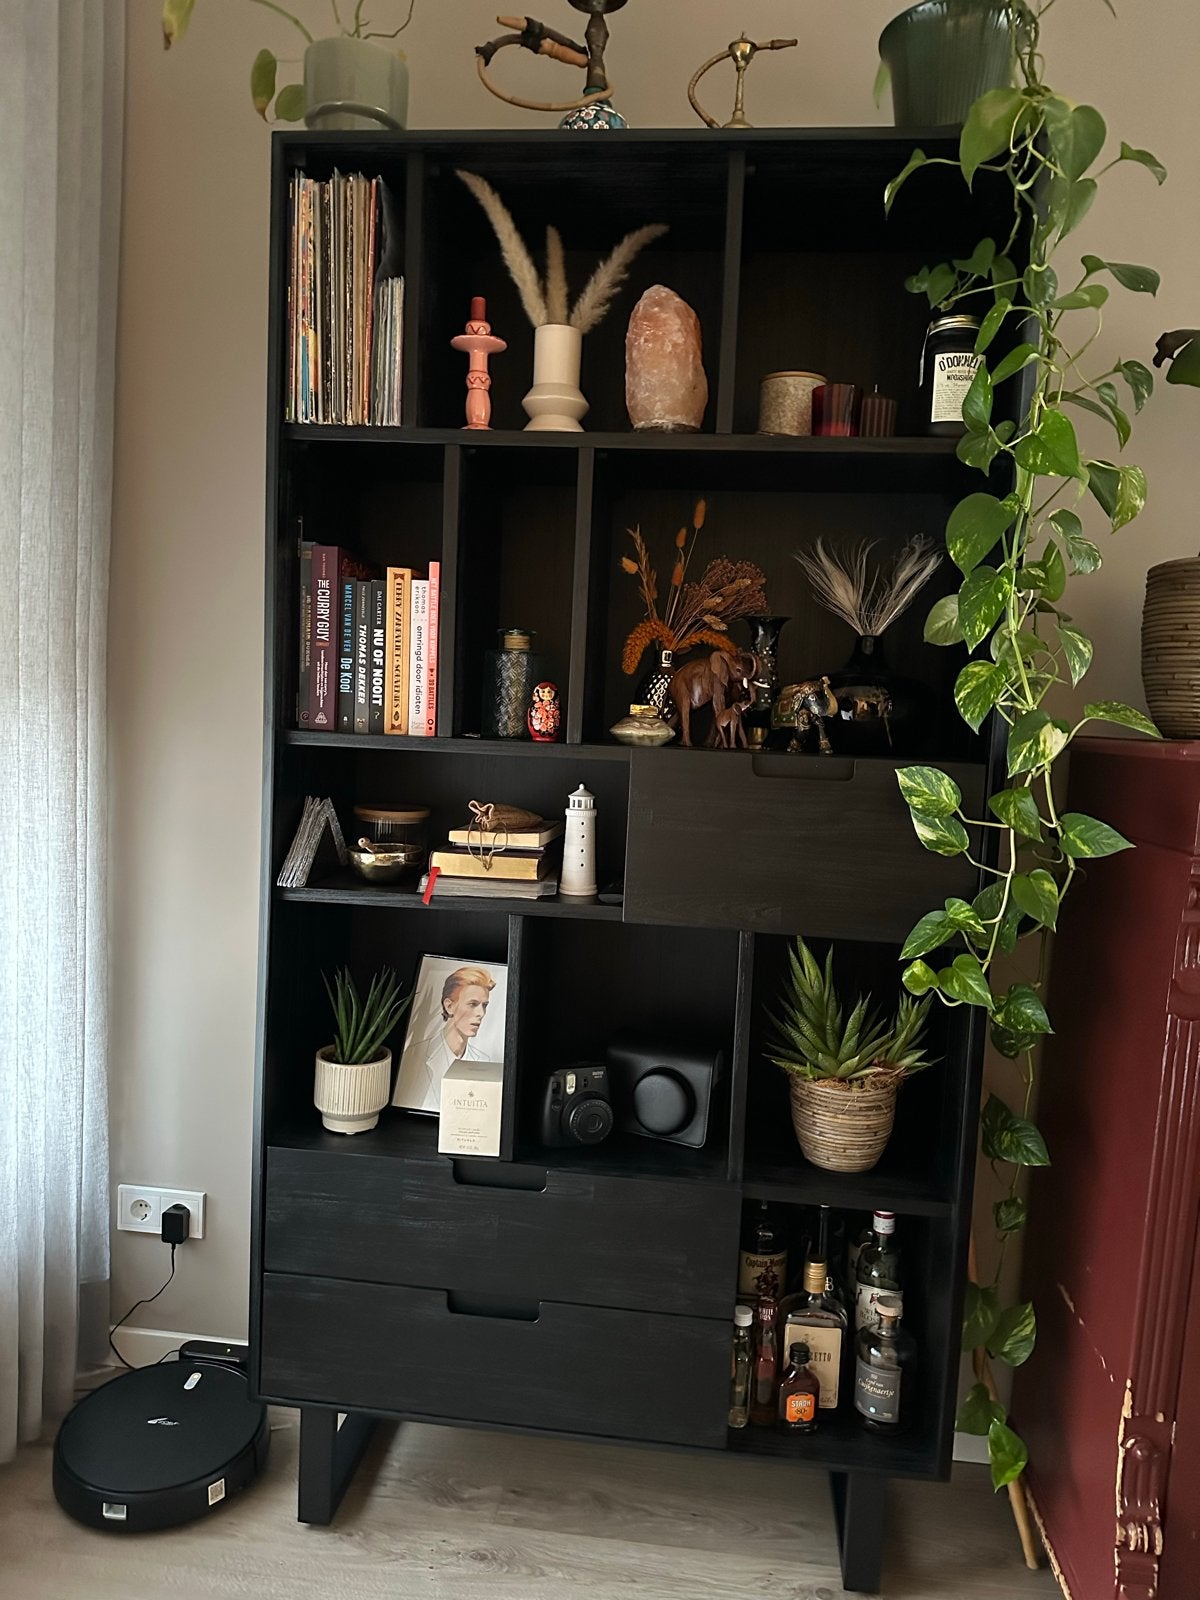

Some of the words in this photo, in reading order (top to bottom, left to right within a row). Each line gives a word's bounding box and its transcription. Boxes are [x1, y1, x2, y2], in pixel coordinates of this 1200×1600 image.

[317, 579, 330, 588] THE
[316, 588, 331, 621] CURRY
[344, 584, 352, 611] MARCEL
[344, 613, 352, 627] VAN
[316, 621, 330, 641] GUY
[343, 628, 352, 637] DE
[373, 628, 384, 647] NU
[343, 639, 351, 652] VEN
[358, 624, 367, 665] THOMAS
[414, 625, 424, 662] omringd
[340, 657, 353, 670] De
[372, 649, 384, 666] OF
[339, 672, 353, 693] Kooi
[414, 663, 423, 683] door
[357, 666, 366, 704] DEKKER
[372, 668, 383, 707] NOOIT
[393, 664, 401, 709] SOUVENIRS
[414, 685, 423, 715] idioten
[427, 686, 435, 710] BATTLES
[745, 1256, 768, 1269] Captain
[791, 1400, 811, 1408] STROH
